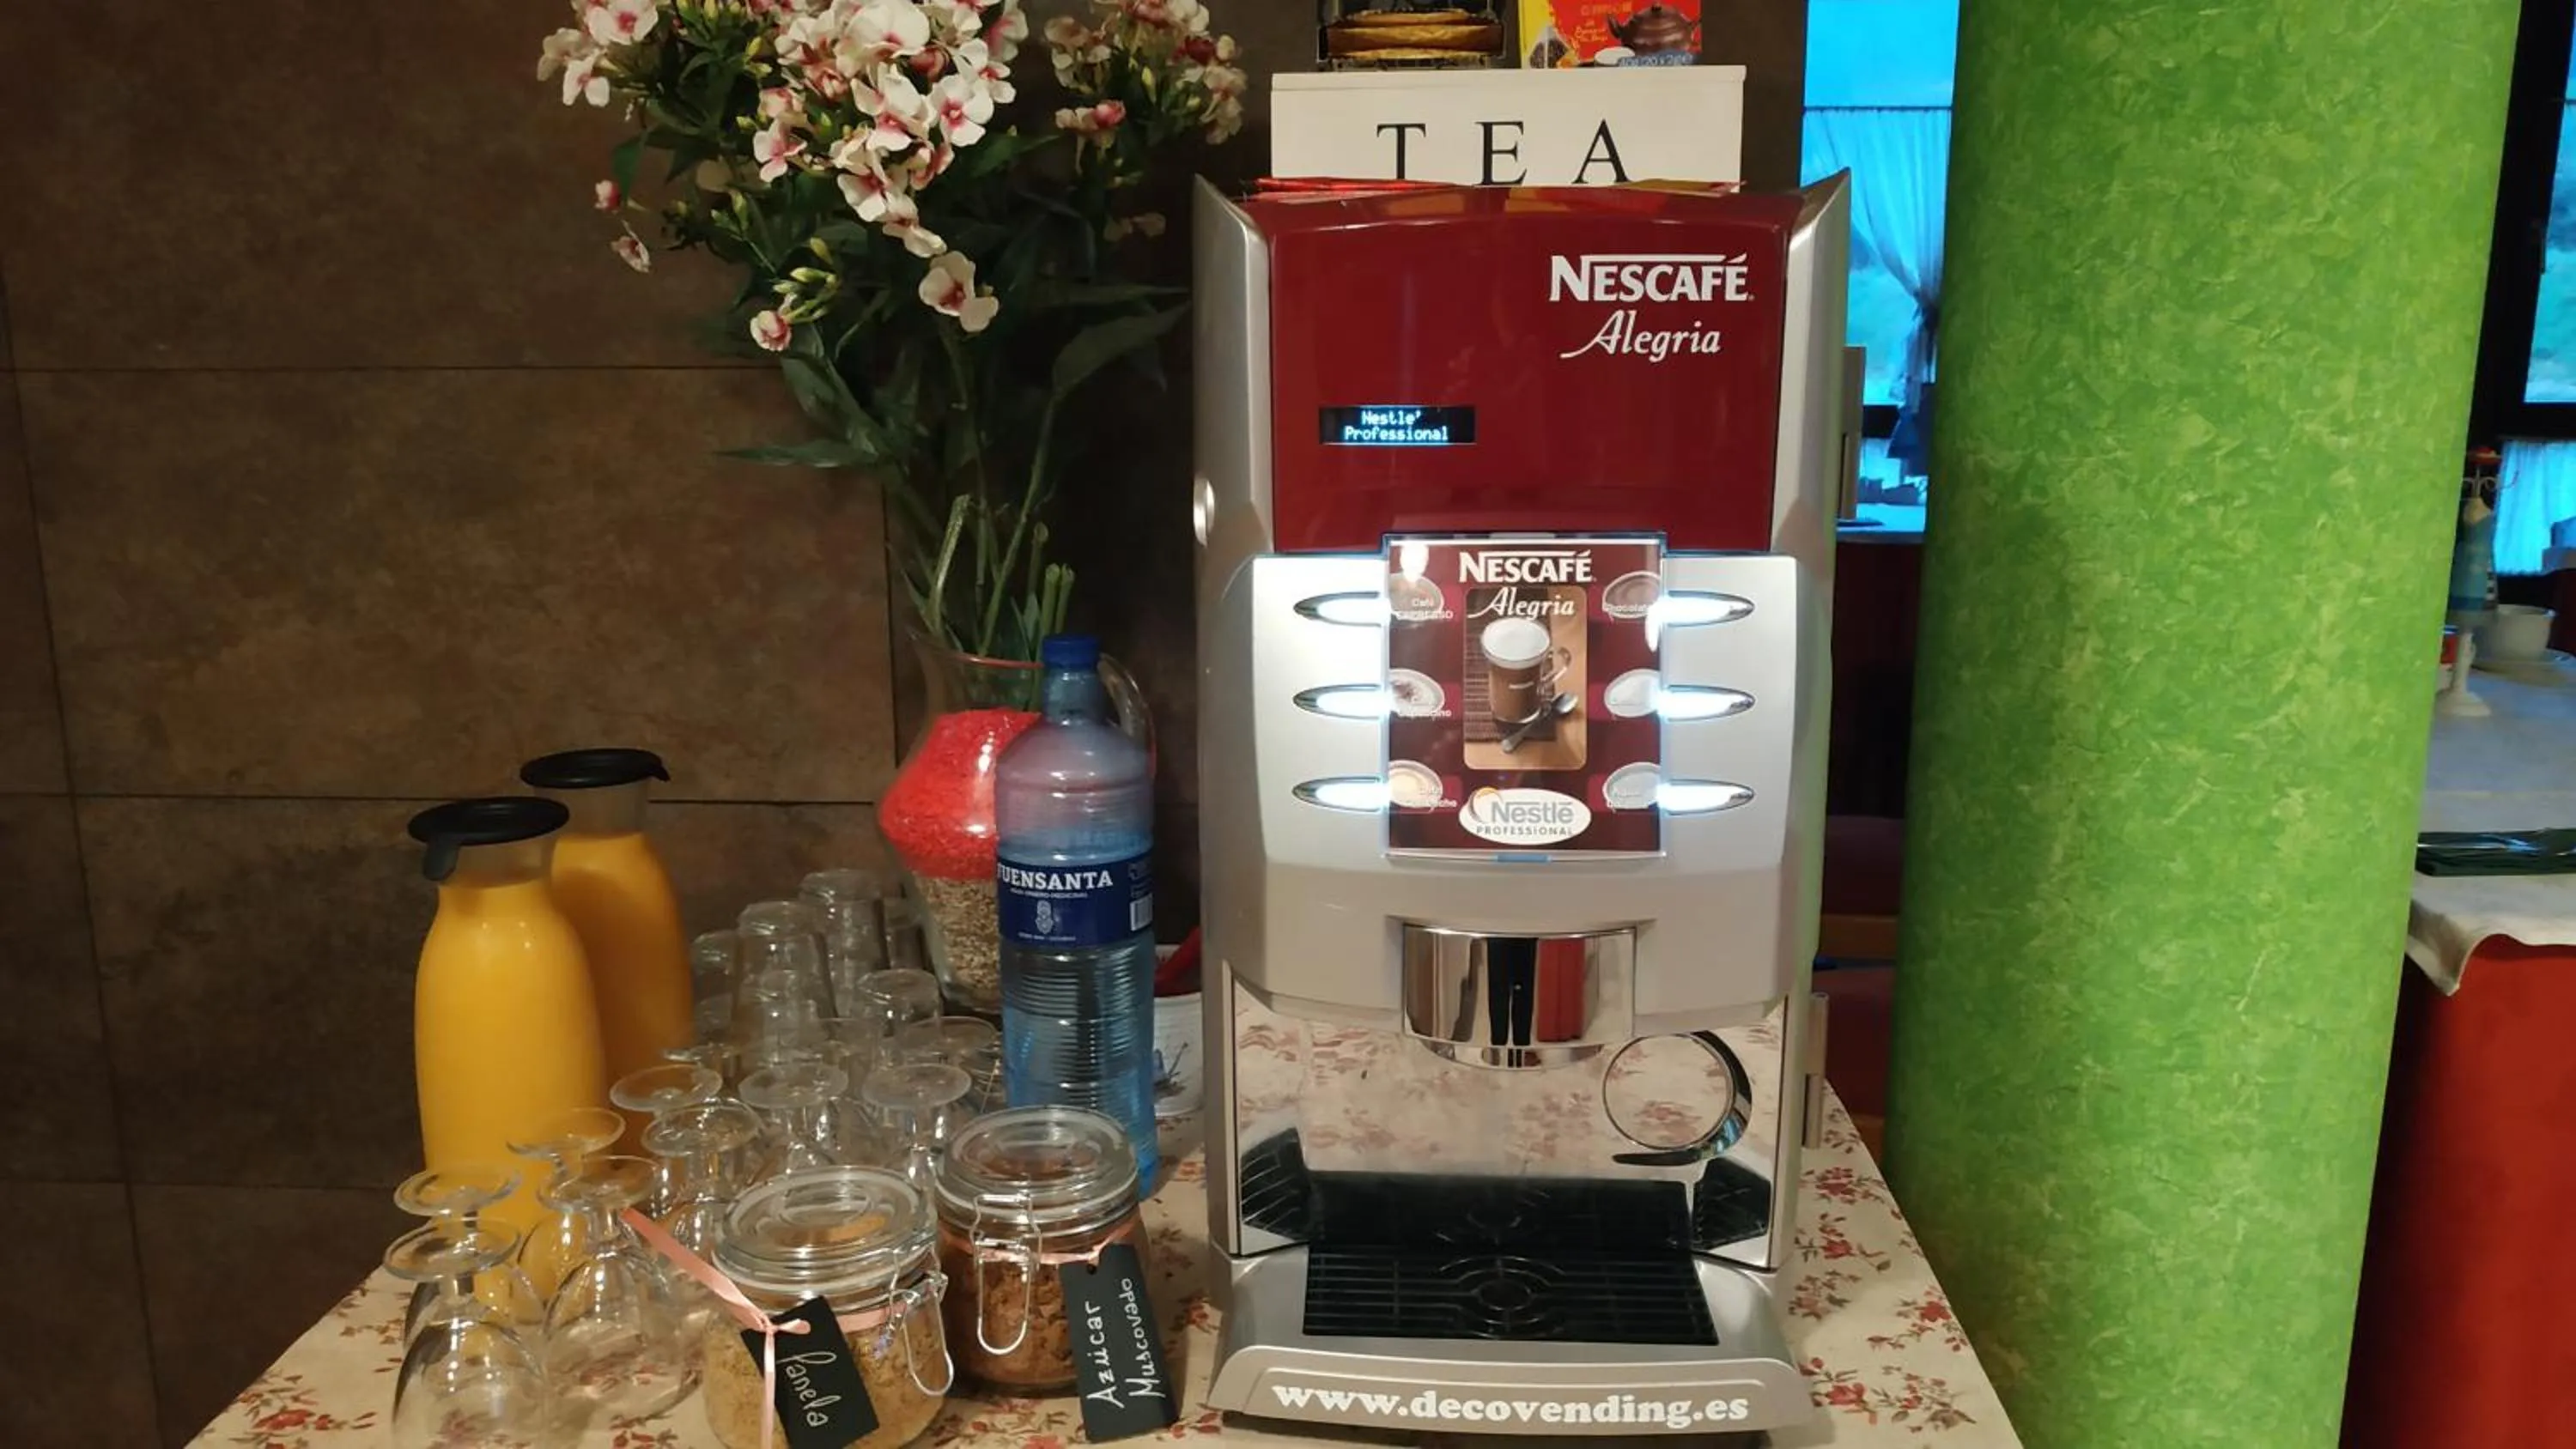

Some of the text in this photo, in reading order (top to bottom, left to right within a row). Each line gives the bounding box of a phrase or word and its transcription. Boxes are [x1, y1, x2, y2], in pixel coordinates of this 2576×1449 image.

[1376, 118, 1633, 186] TEA
[1549, 252, 1750, 302] NESCAFÉ
[1560, 310, 1722, 363] Alegria
[1344, 425, 1449, 441] Professional
[1459, 549, 1592, 583] NESCAFÉ
[1467, 586, 1576, 620] Alegria
[1491, 801, 1574, 824] Nestlé
[1272, 1383, 1749, 1428] www.decovending.es
